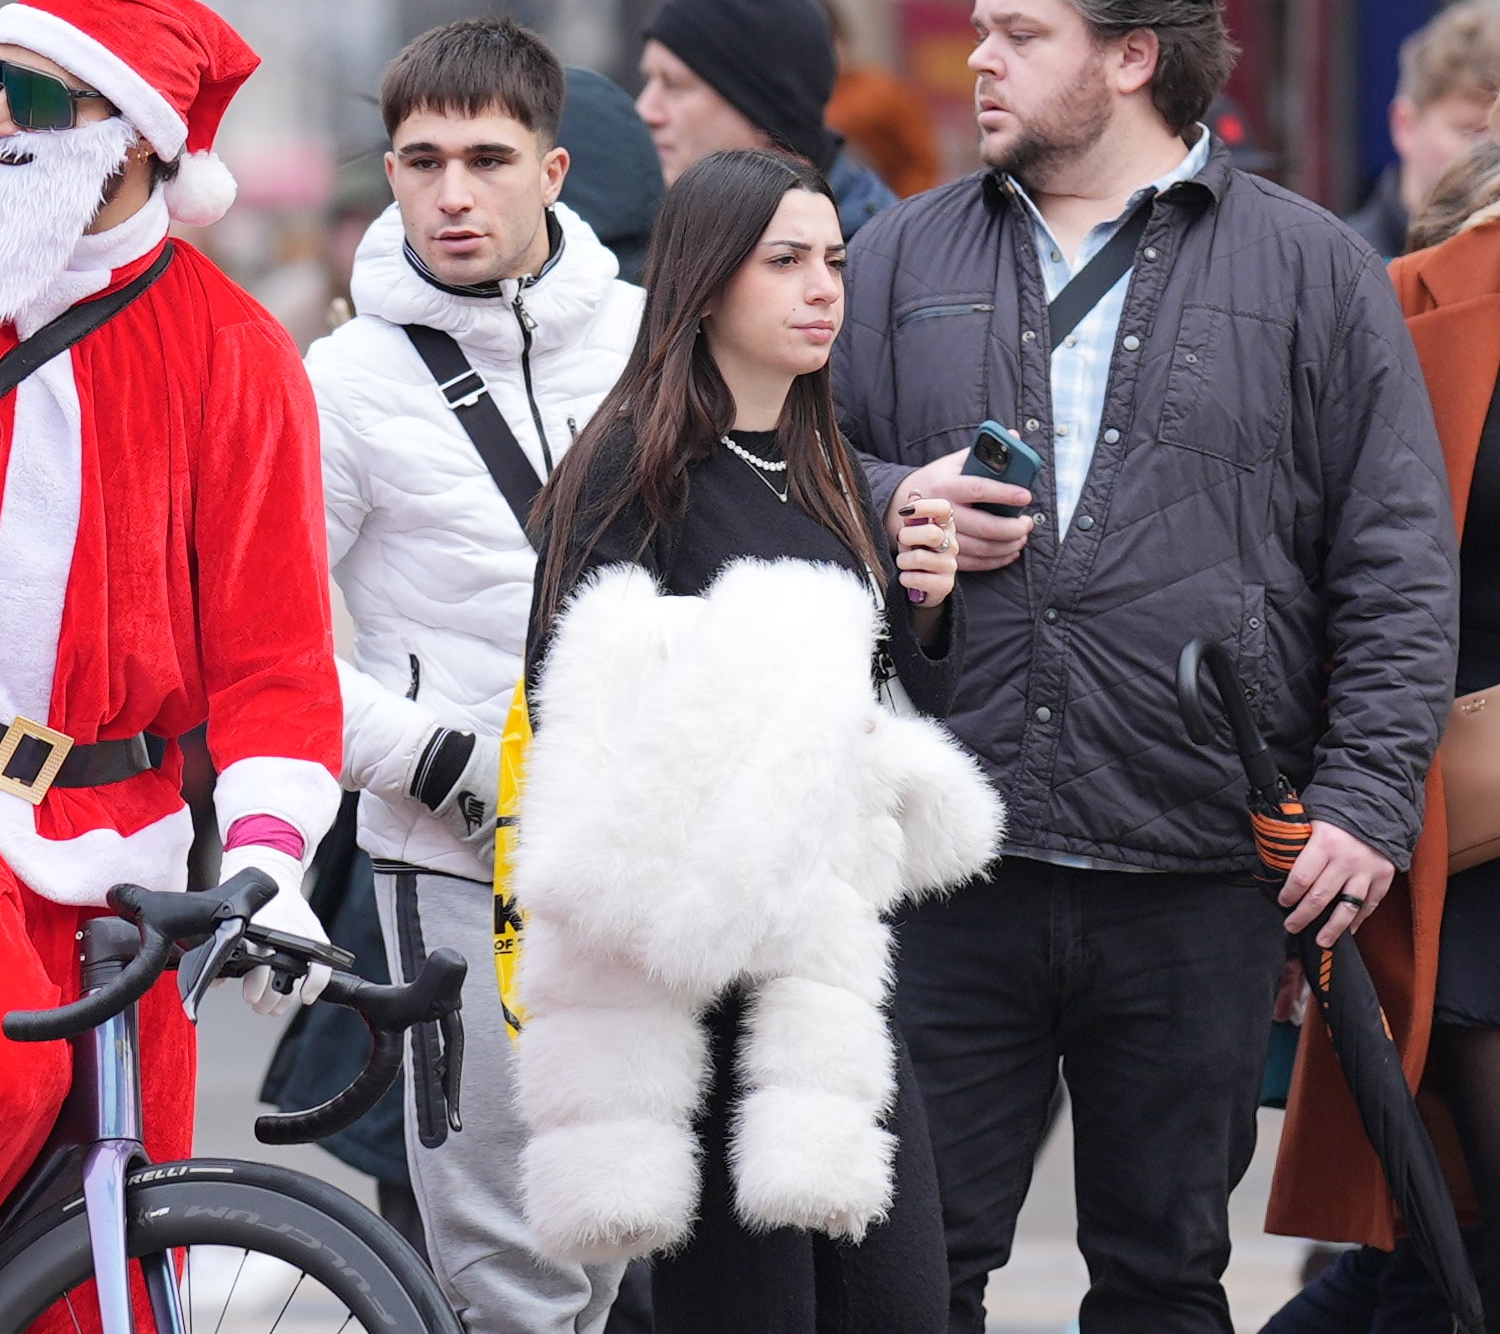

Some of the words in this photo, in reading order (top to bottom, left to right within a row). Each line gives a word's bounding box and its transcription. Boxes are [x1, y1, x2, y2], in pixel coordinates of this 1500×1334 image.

[468, 797, 485, 828] NIKE
[494, 938, 514, 950] OF
[128, 1166, 189, 1186] RELLI
[184, 1204, 398, 1327] FULCRUM
